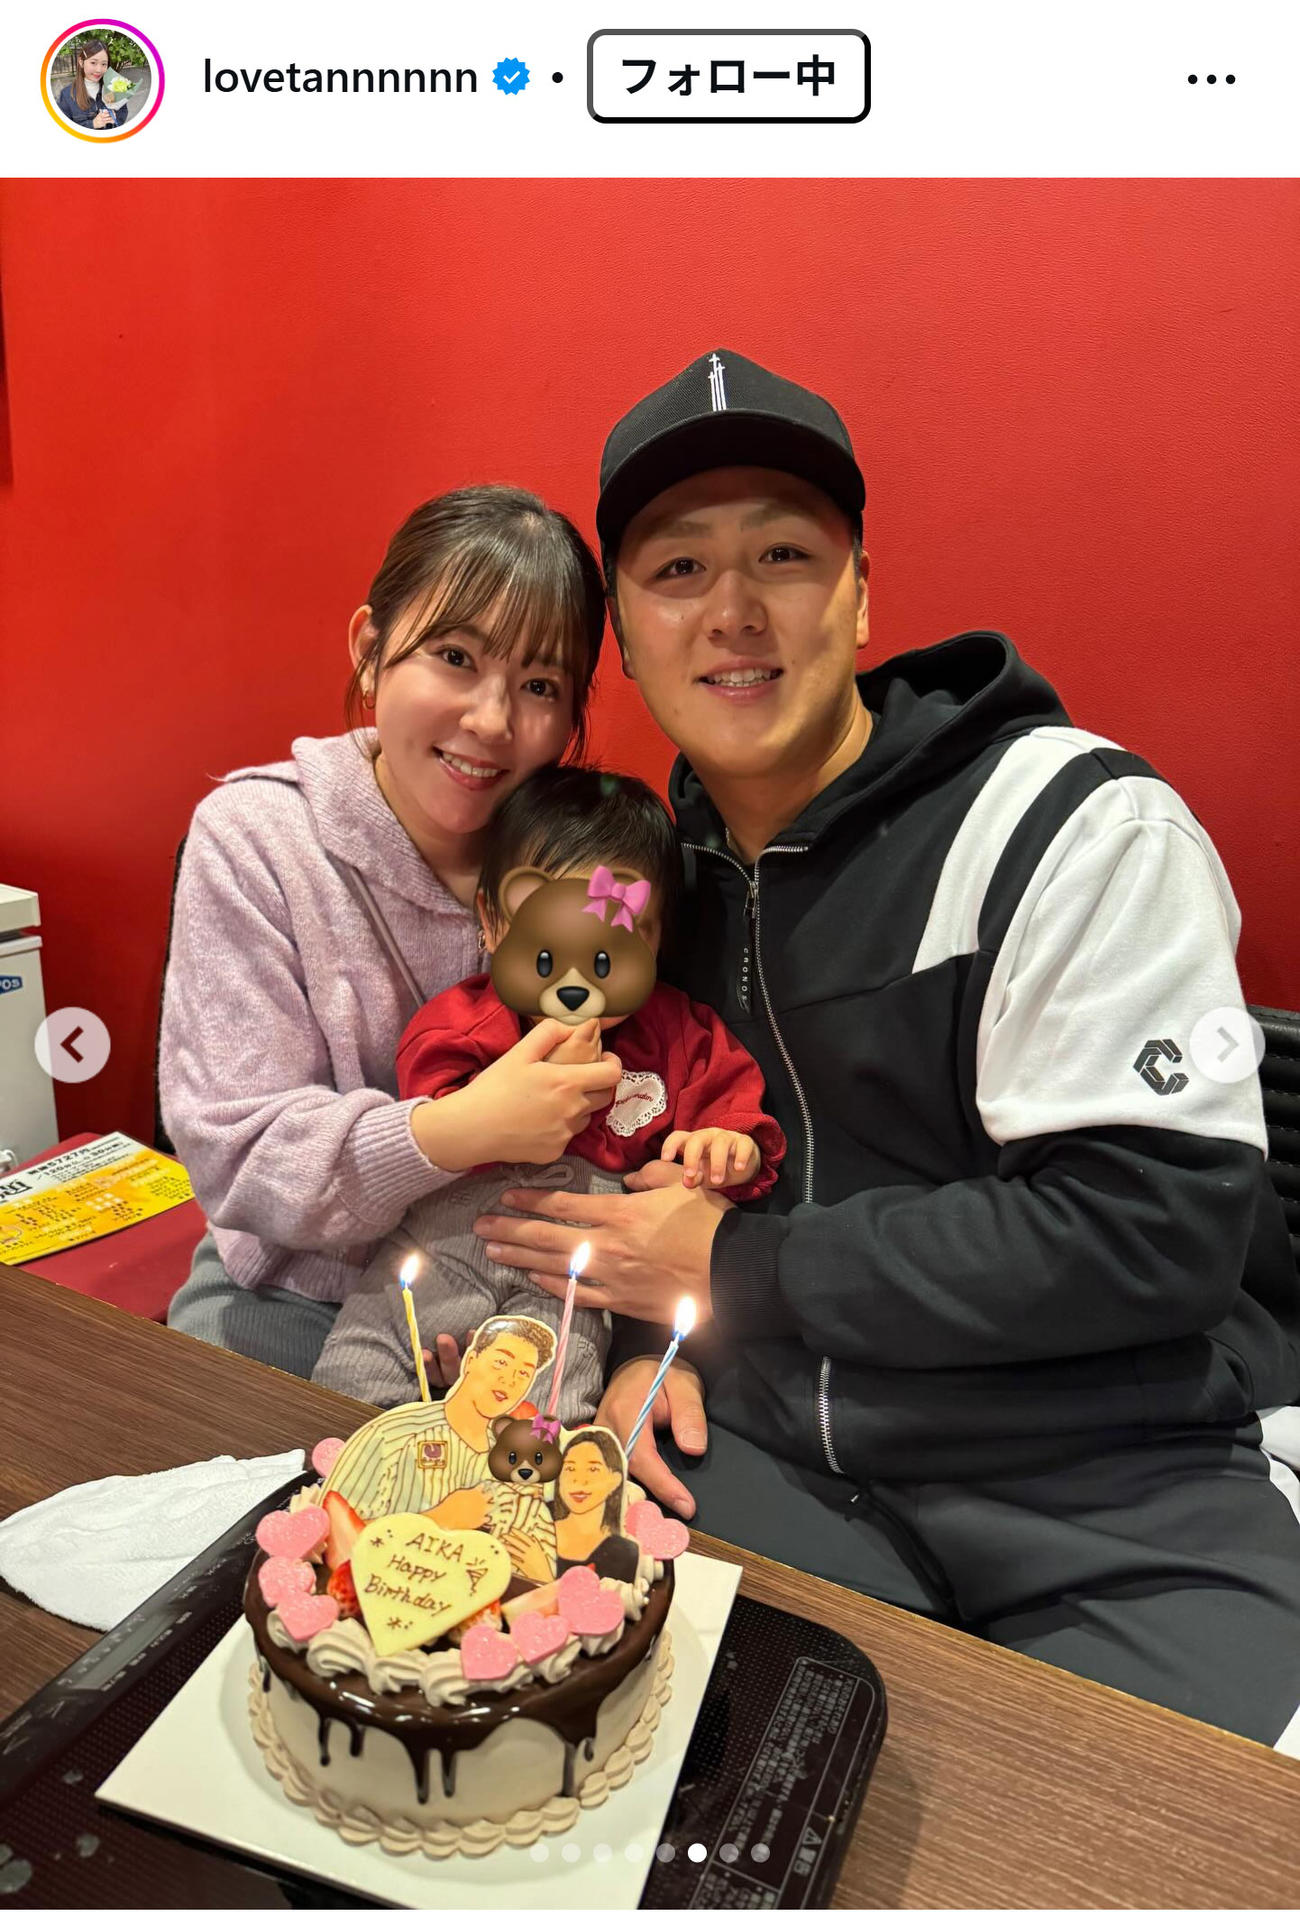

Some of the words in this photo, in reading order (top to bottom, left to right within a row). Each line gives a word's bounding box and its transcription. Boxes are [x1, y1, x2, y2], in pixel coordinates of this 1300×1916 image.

[405, 1532, 464, 1563] AIKA
[387, 1553, 447, 1584] Happy
[364, 1572, 453, 1617] Birthday
